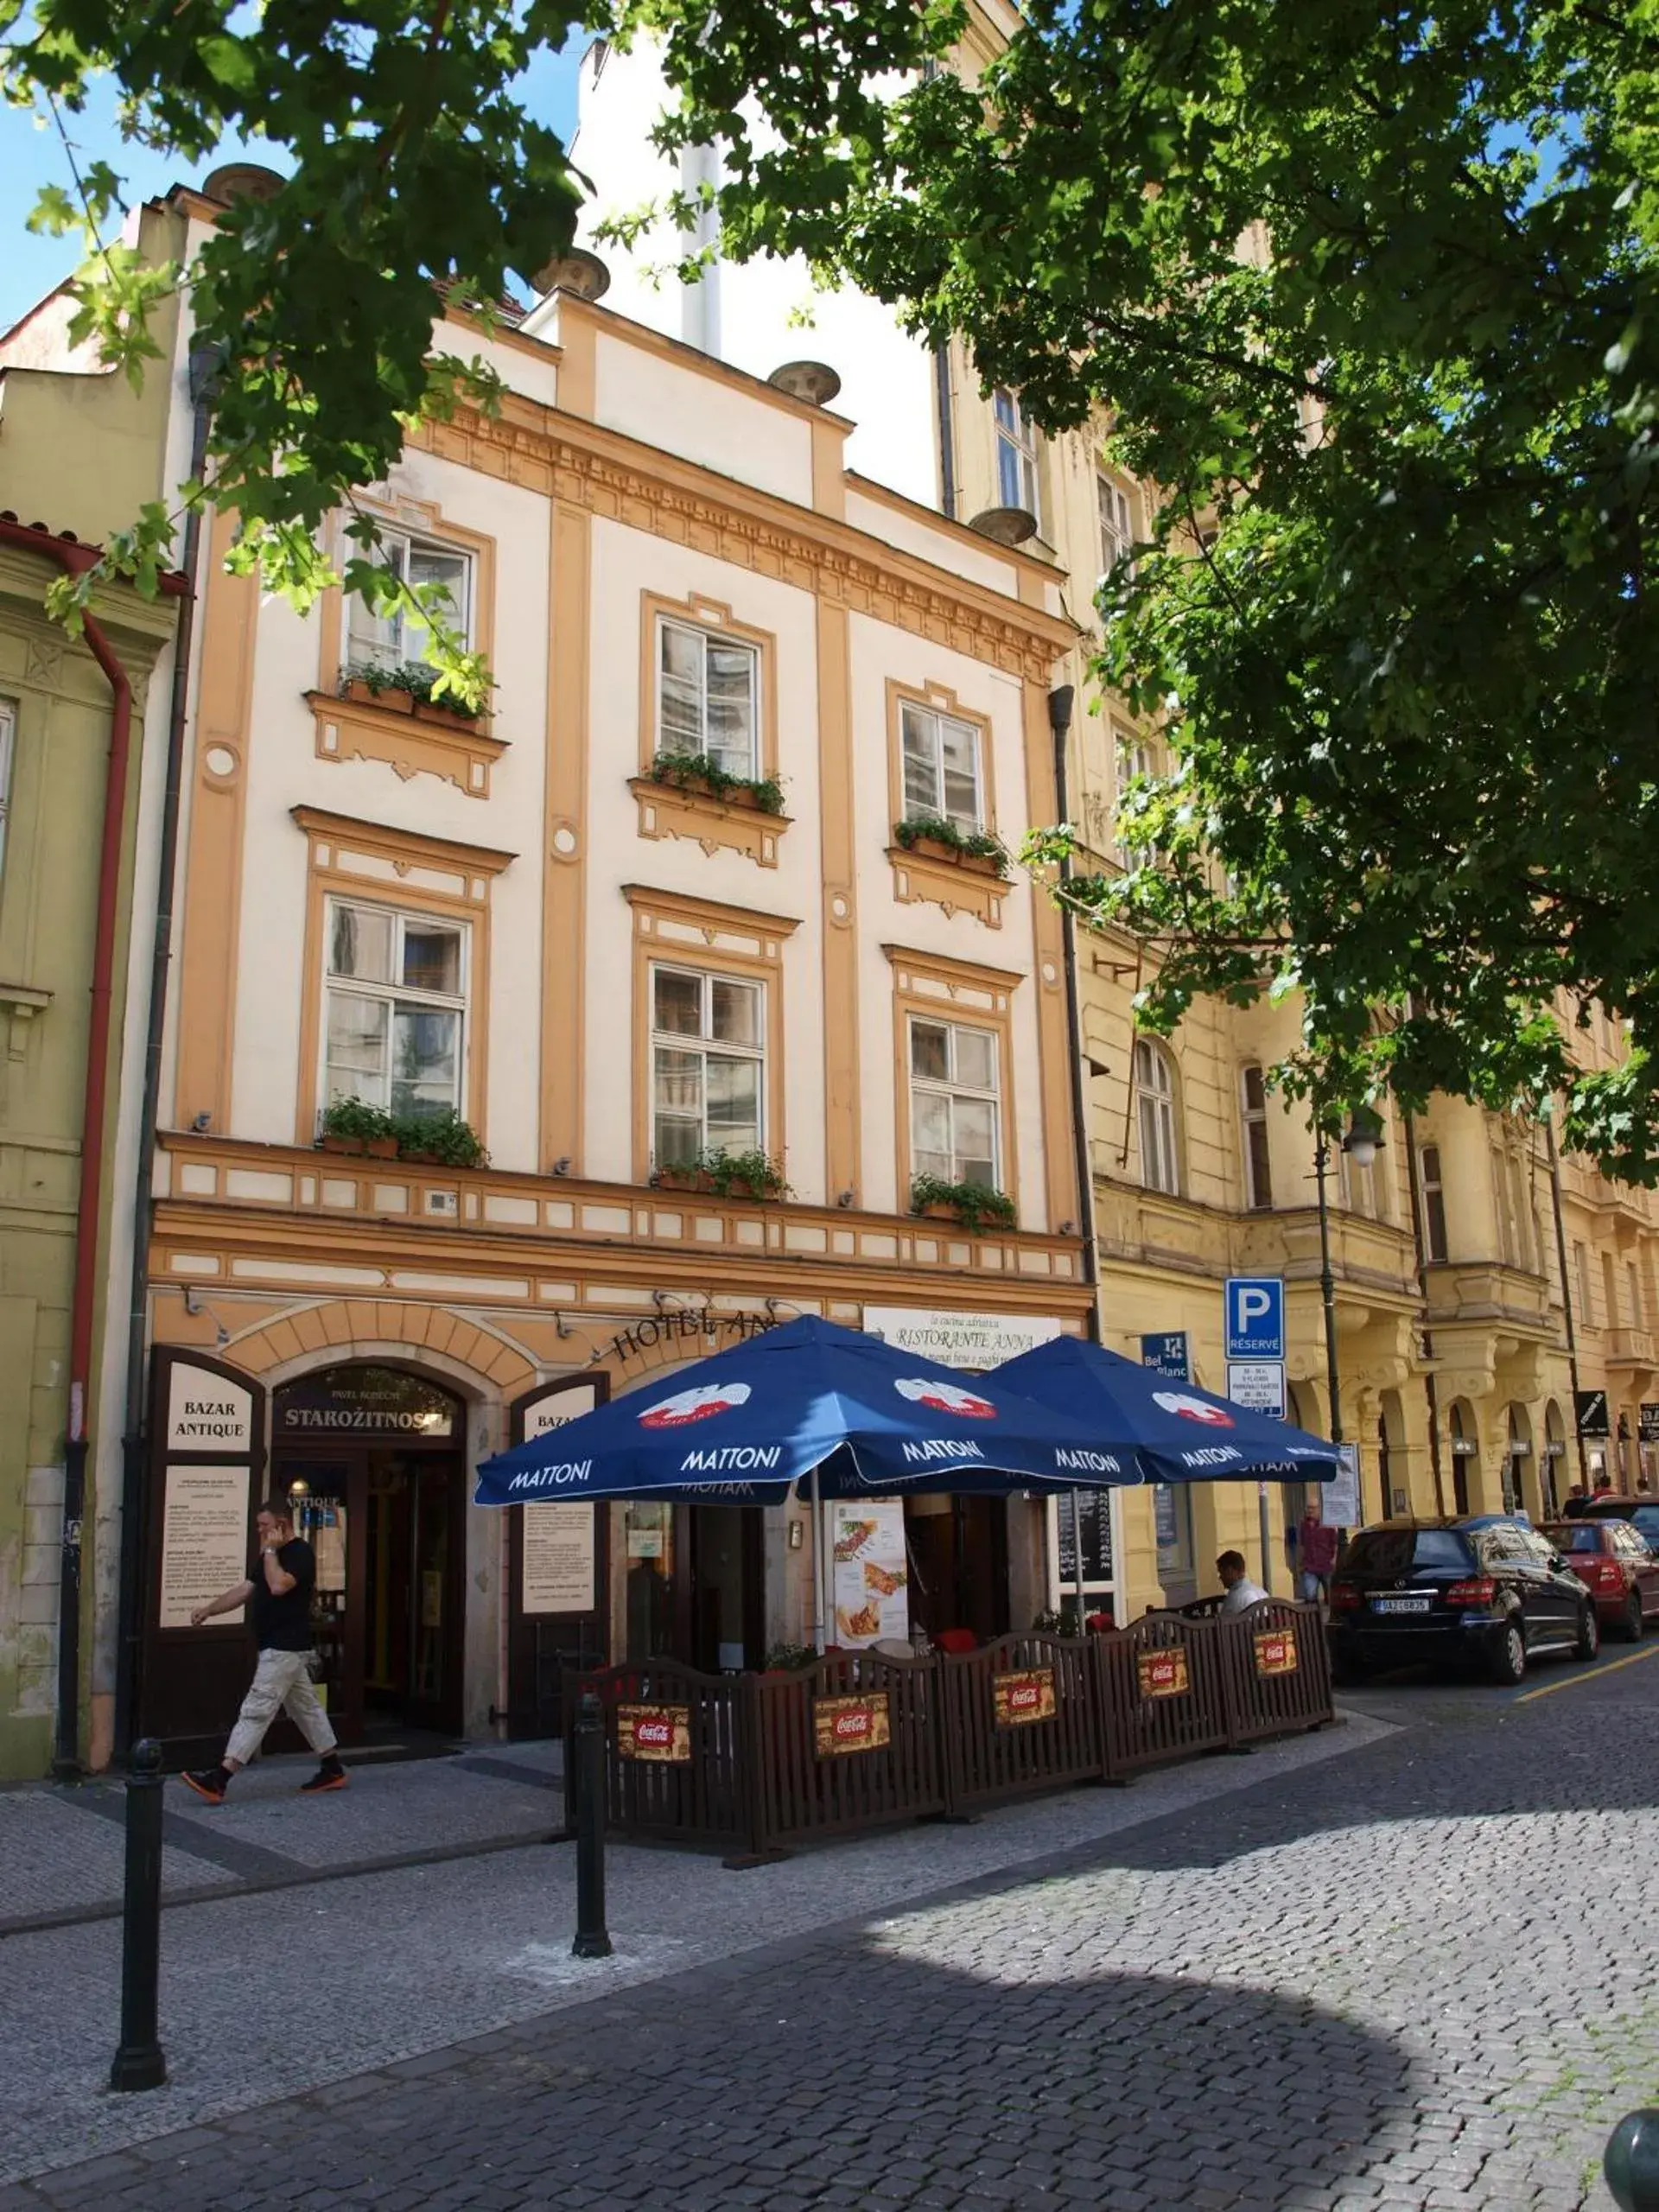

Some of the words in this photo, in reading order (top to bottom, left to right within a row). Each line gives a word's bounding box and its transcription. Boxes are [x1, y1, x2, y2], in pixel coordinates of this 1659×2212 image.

[1238, 1288, 1271, 1333] P
[613, 1308, 716, 1362] HOTEL
[897, 1329, 989, 1350] RISTORANTE
[993, 1333, 1033, 1350] ANNA
[1145, 1356, 1162, 1367] Bel
[185, 1402, 235, 1415] BAZAR
[286, 1406, 445, 1428] STAROŽITNOS
[176, 1422, 244, 1438] ANTIQUE
[680, 1446, 781, 1471] MATTONI
[901, 1440, 985, 1462] MATTONI
[1055, 1446, 1121, 1472] MATTONI
[1180, 1446, 1243, 1467] MATTONI
[508, 1459, 593, 1491] MATTONI
